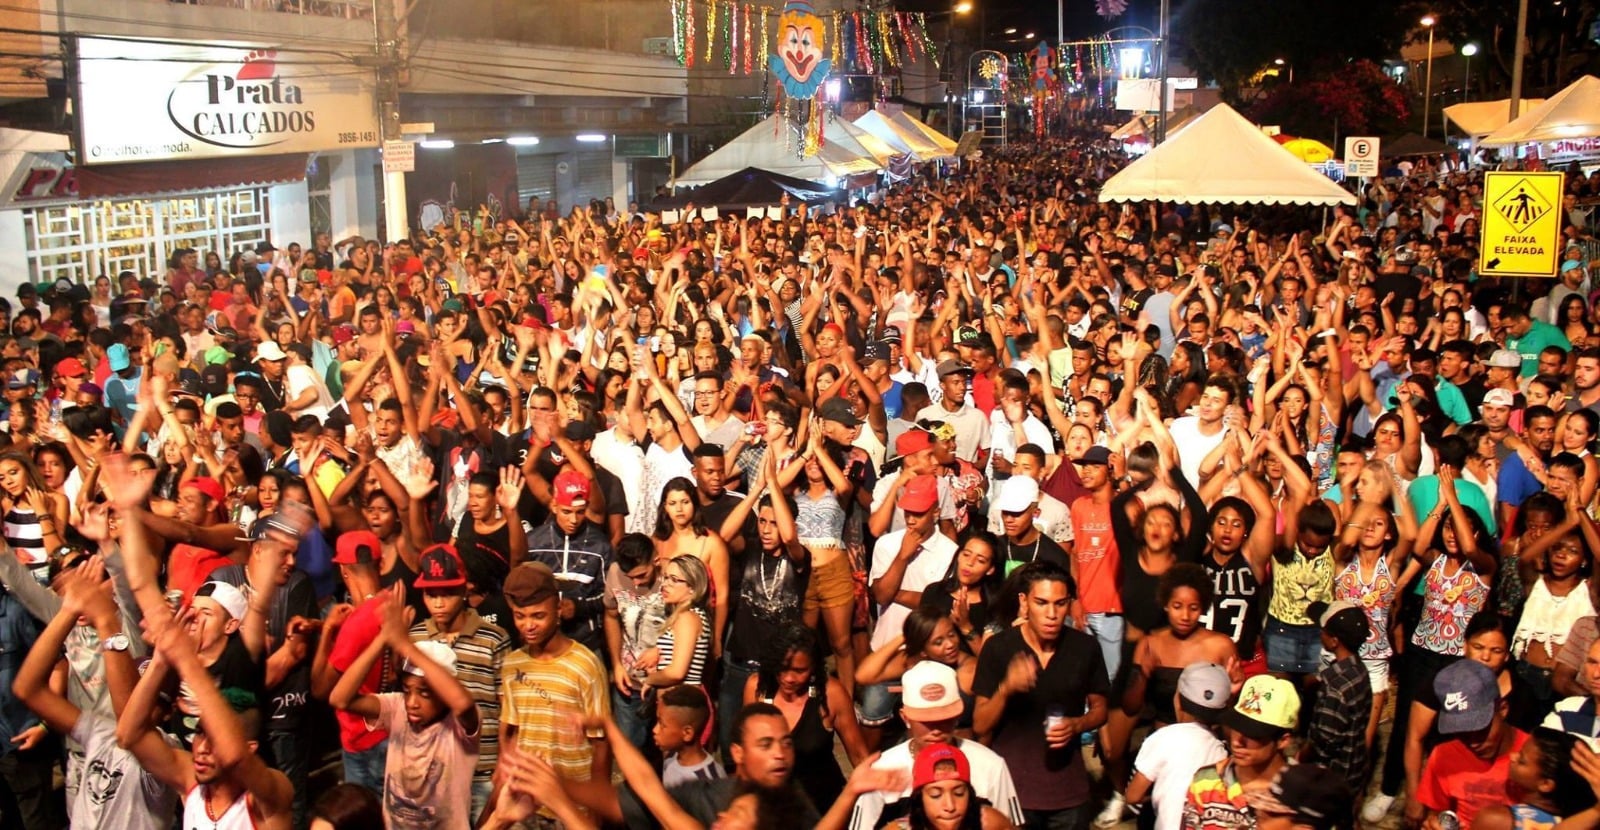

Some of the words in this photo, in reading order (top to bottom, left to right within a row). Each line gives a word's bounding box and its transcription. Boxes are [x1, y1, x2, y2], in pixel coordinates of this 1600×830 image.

[206, 74, 303, 104] Prata
[193, 111, 315, 140] CALÇADOS
[1358, 144, 1366, 154] E
[1504, 235, 1536, 244] FAIXA
[1494, 246, 1545, 255] ELEVADA
[1201, 563, 1256, 596] HIC
